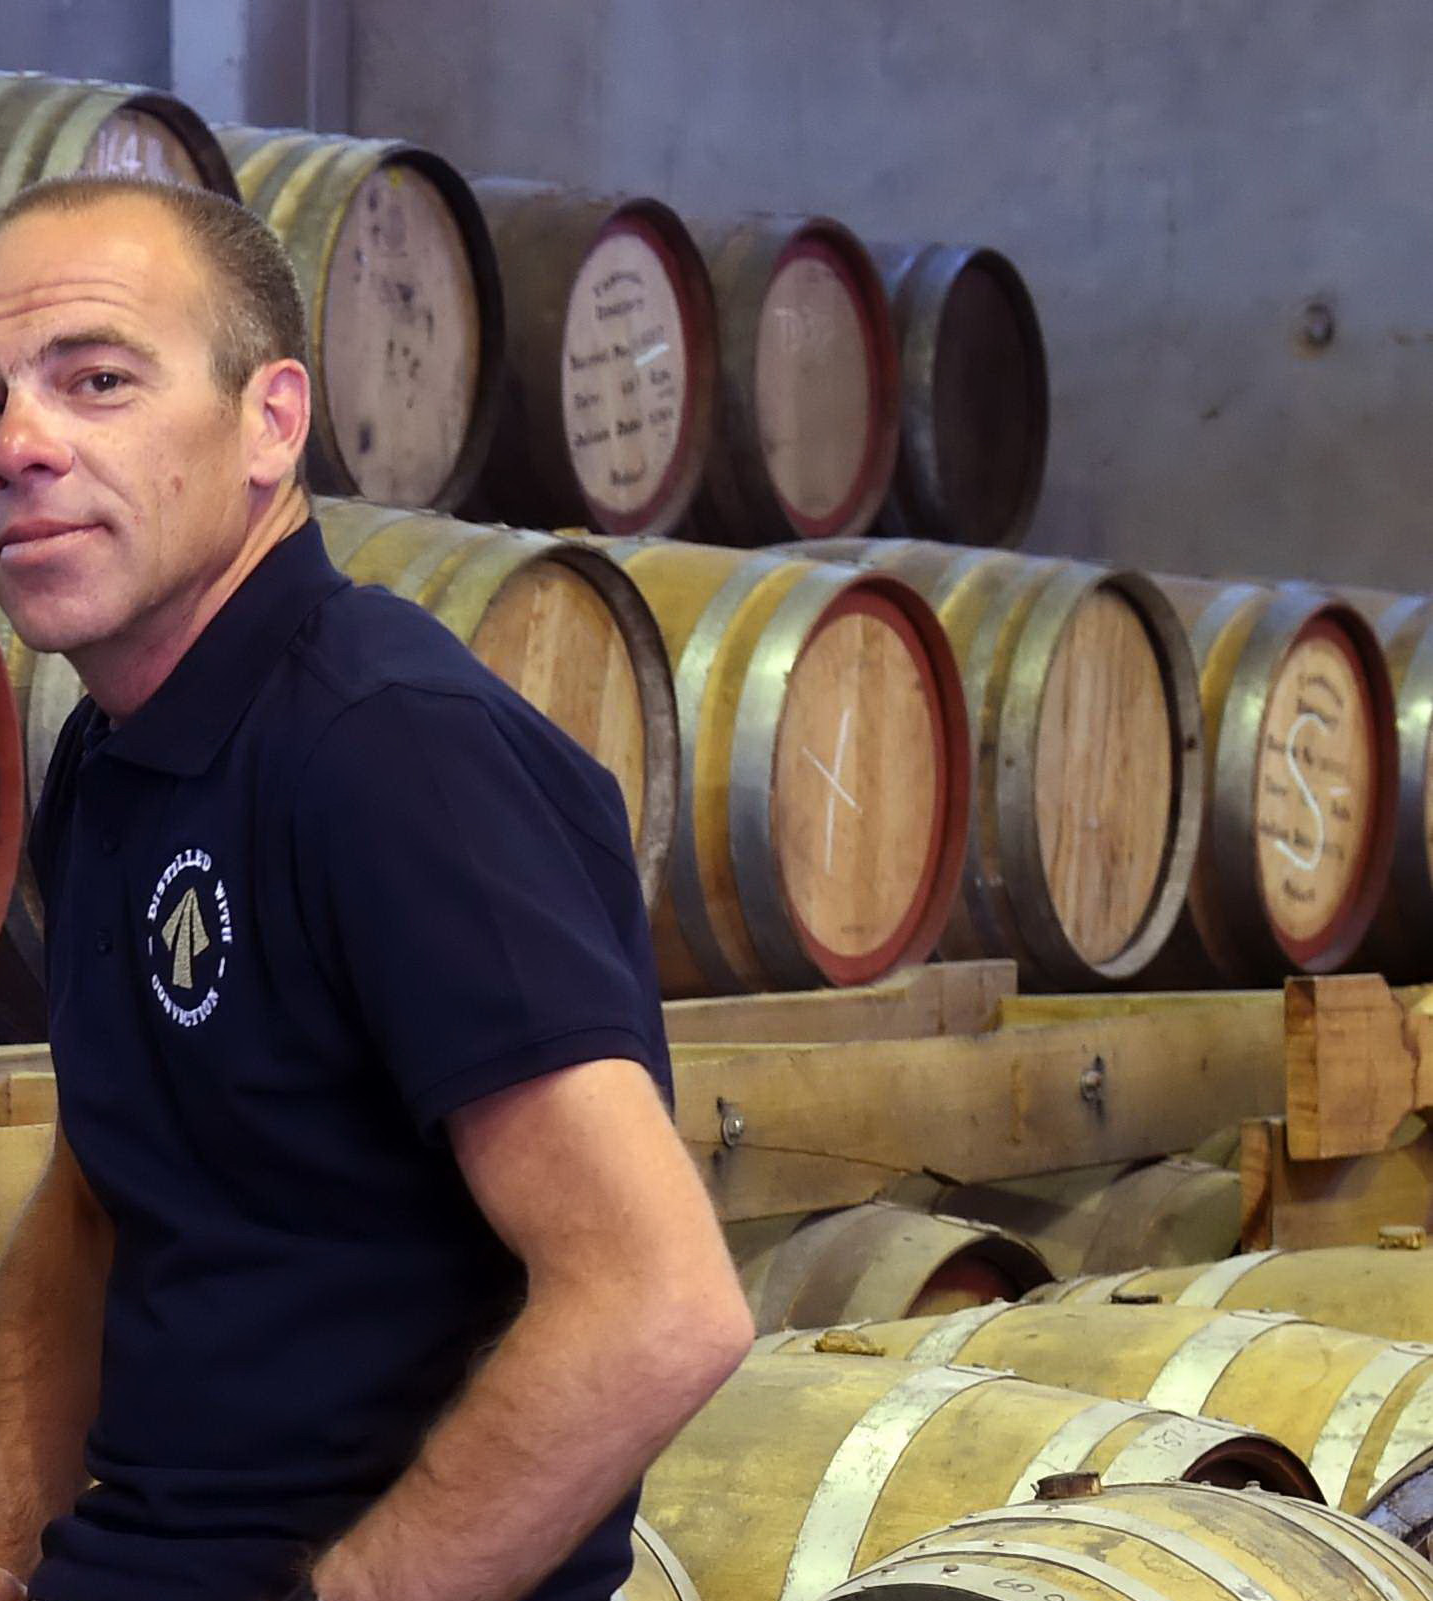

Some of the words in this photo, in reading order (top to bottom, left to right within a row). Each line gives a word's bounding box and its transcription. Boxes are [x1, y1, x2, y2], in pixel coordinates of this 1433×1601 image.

[147, 849, 213, 921] DISTILLED
[214, 879, 233, 944] WITH
[151, 973, 220, 1028] CONVICTION
